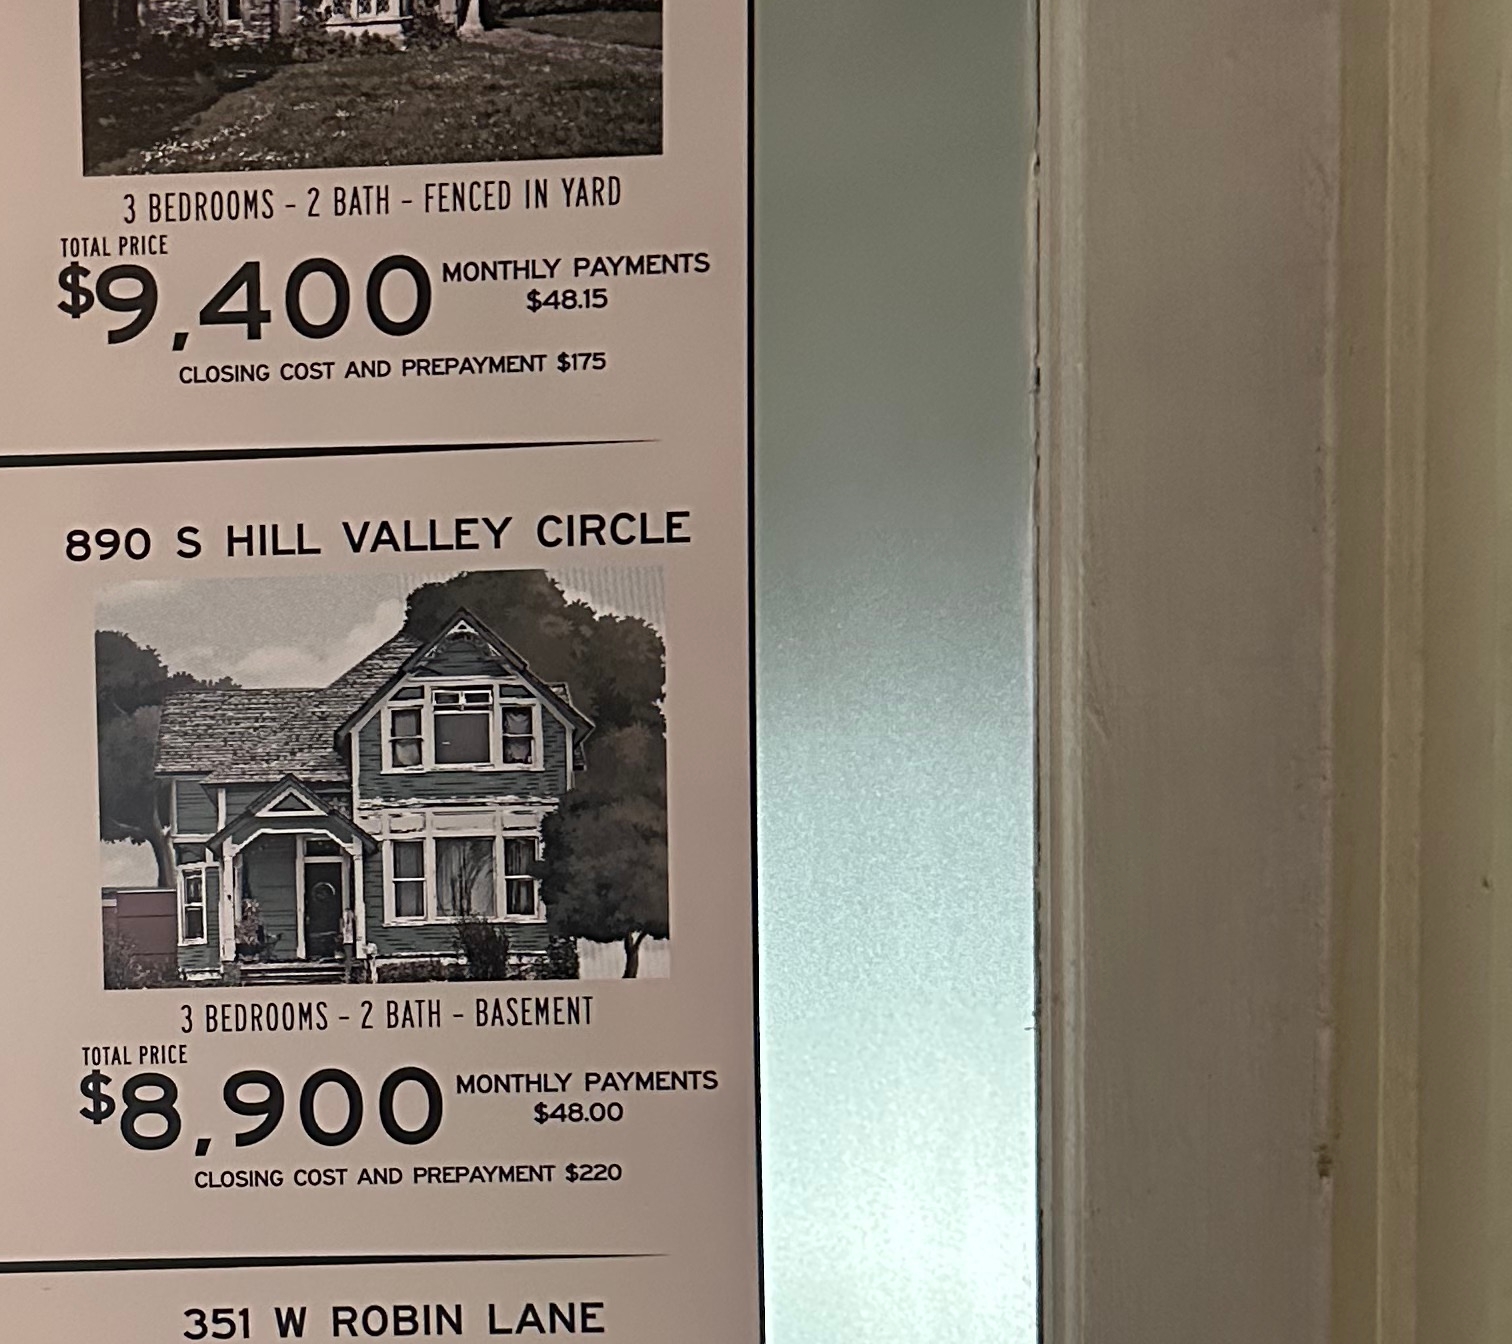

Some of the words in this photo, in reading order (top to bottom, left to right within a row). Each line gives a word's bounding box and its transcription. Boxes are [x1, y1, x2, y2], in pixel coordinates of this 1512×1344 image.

[123, 193, 136, 225] 3
[148, 188, 274, 223] BEDROOMS
[307, 186, 320, 218] 2
[333, 184, 390, 217] BATH
[424, 180, 511, 213] FENCED
[525, 178, 548, 210] IN
[561, 175, 621, 208] YARD
[60, 236, 112, 258] TOTAL
[118, 234, 168, 256] PRICE
[442, 258, 562, 283] MONTHLY
[573, 252, 711, 278] PAYMENTS
[57, 254, 432, 352] $9,400
[526, 287, 609, 313] $48.15
[179, 363, 270, 384] CLOSING
[279, 361, 336, 381] COST
[344, 359, 392, 379] AND
[402, 353, 548, 377] PREPAYMENT
[556, 351, 607, 373] $175
[65, 527, 151, 562] 890
[176, 526, 202, 559] S
[227, 523, 322, 557] HILL
[341, 516, 513, 554] VALLEY
[536, 510, 691, 548] CIRCLE
[180, 1004, 193, 1034] 3
[205, 1001, 328, 1033] BEDROOMS
[360, 1000, 374, 1030] 2
[386, 999, 441, 1029] BATH
[475, 995, 594, 1027] BASEMENT
[81, 1045, 132, 1066] TOTAL
[139, 1044, 188, 1065] PRICE
[456, 1072, 573, 1095] MONTHLY
[584, 1069, 719, 1092] PAYMENTS
[79, 1066, 443, 1157] $8,900
[533, 1101, 624, 1125] $48.00
[194, 1169, 284, 1189] CLOSING
[293, 1168, 348, 1187] COST
[356, 1167, 403, 1185] AND
[413, 1164, 557, 1184] PREPAYMENT
[565, 1162, 623, 1184] $220
[183, 1307, 250, 1341] 351
[274, 1306, 307, 1339] W
[332, 1303, 463, 1338] ROBIN
[488, 1301, 606, 1335] LANE
